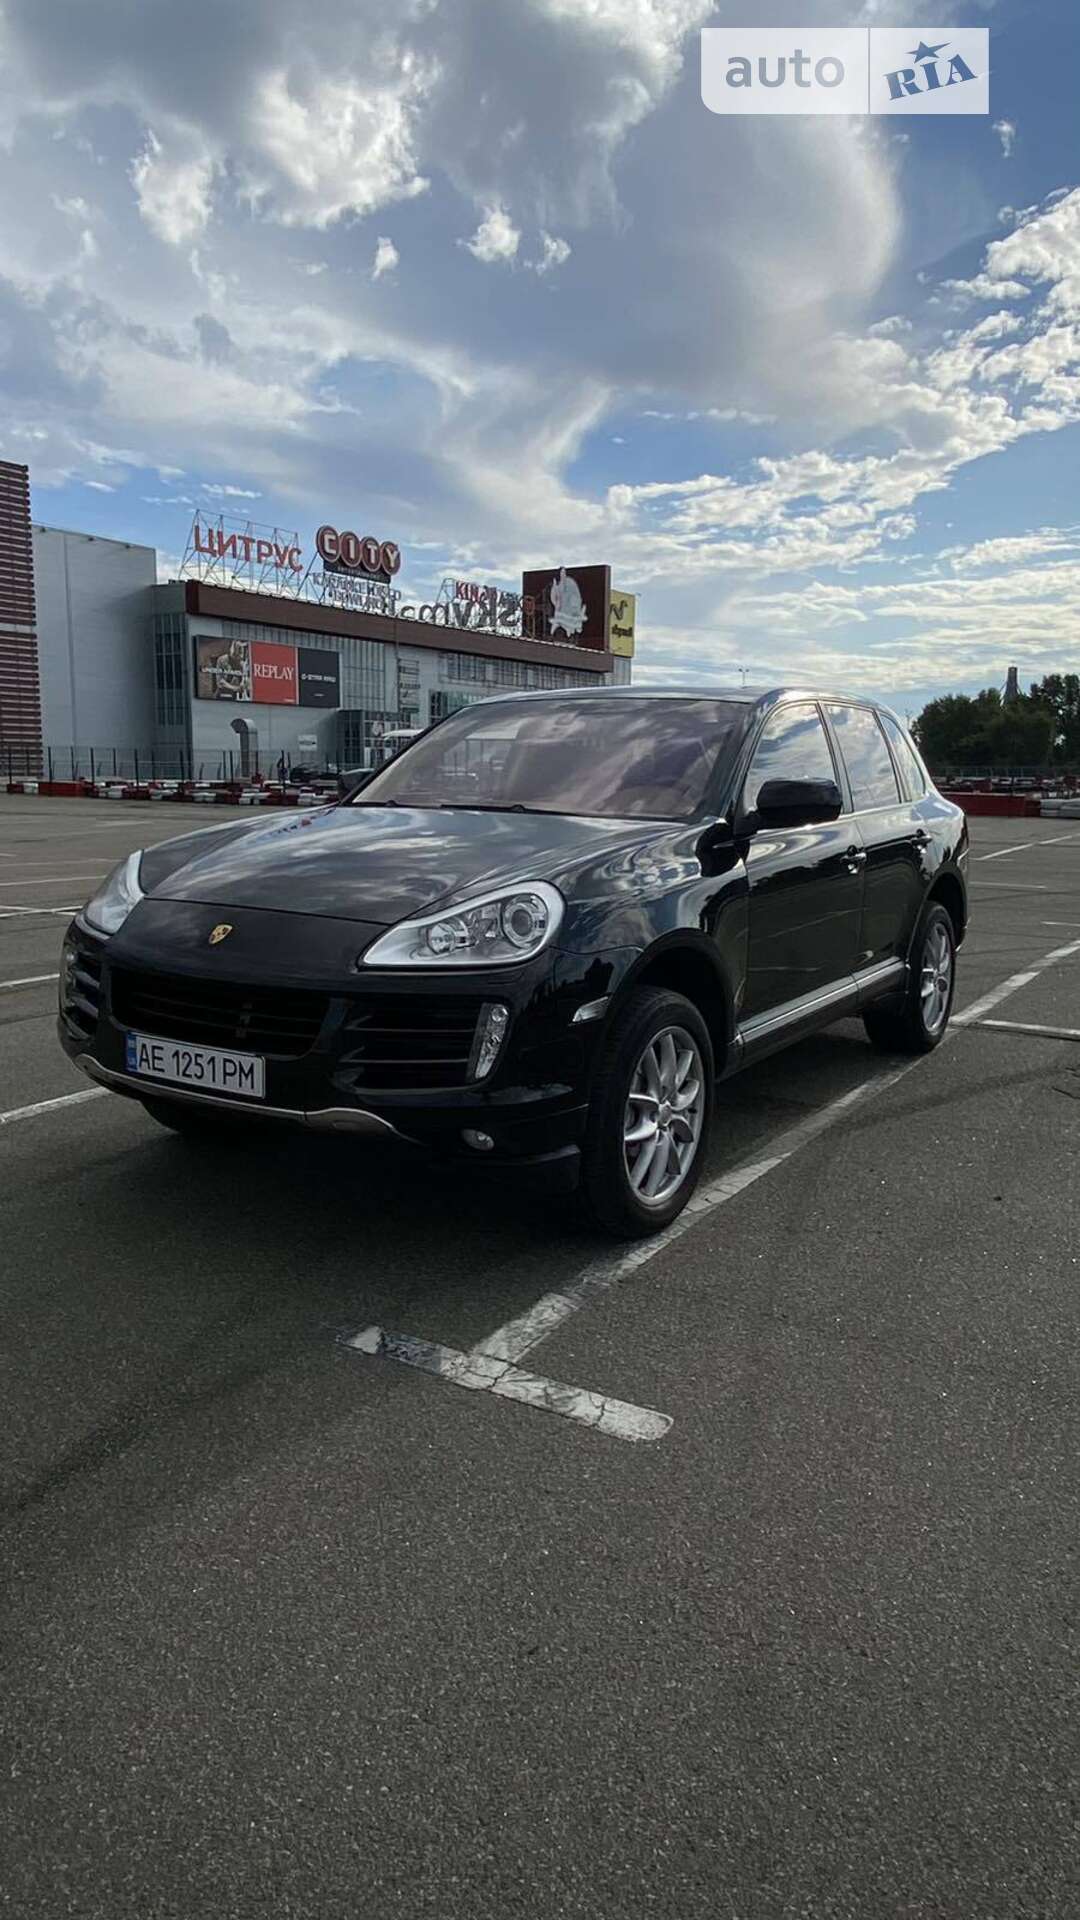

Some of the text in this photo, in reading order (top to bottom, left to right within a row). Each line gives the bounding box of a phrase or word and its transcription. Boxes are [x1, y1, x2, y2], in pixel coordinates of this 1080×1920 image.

[194, 524, 304, 573] ЦИТРУС
[322, 529, 400, 571] CITY
[253, 663, 295, 681] REPLAY
[138, 1043, 255, 1090] AE 1251 PM
